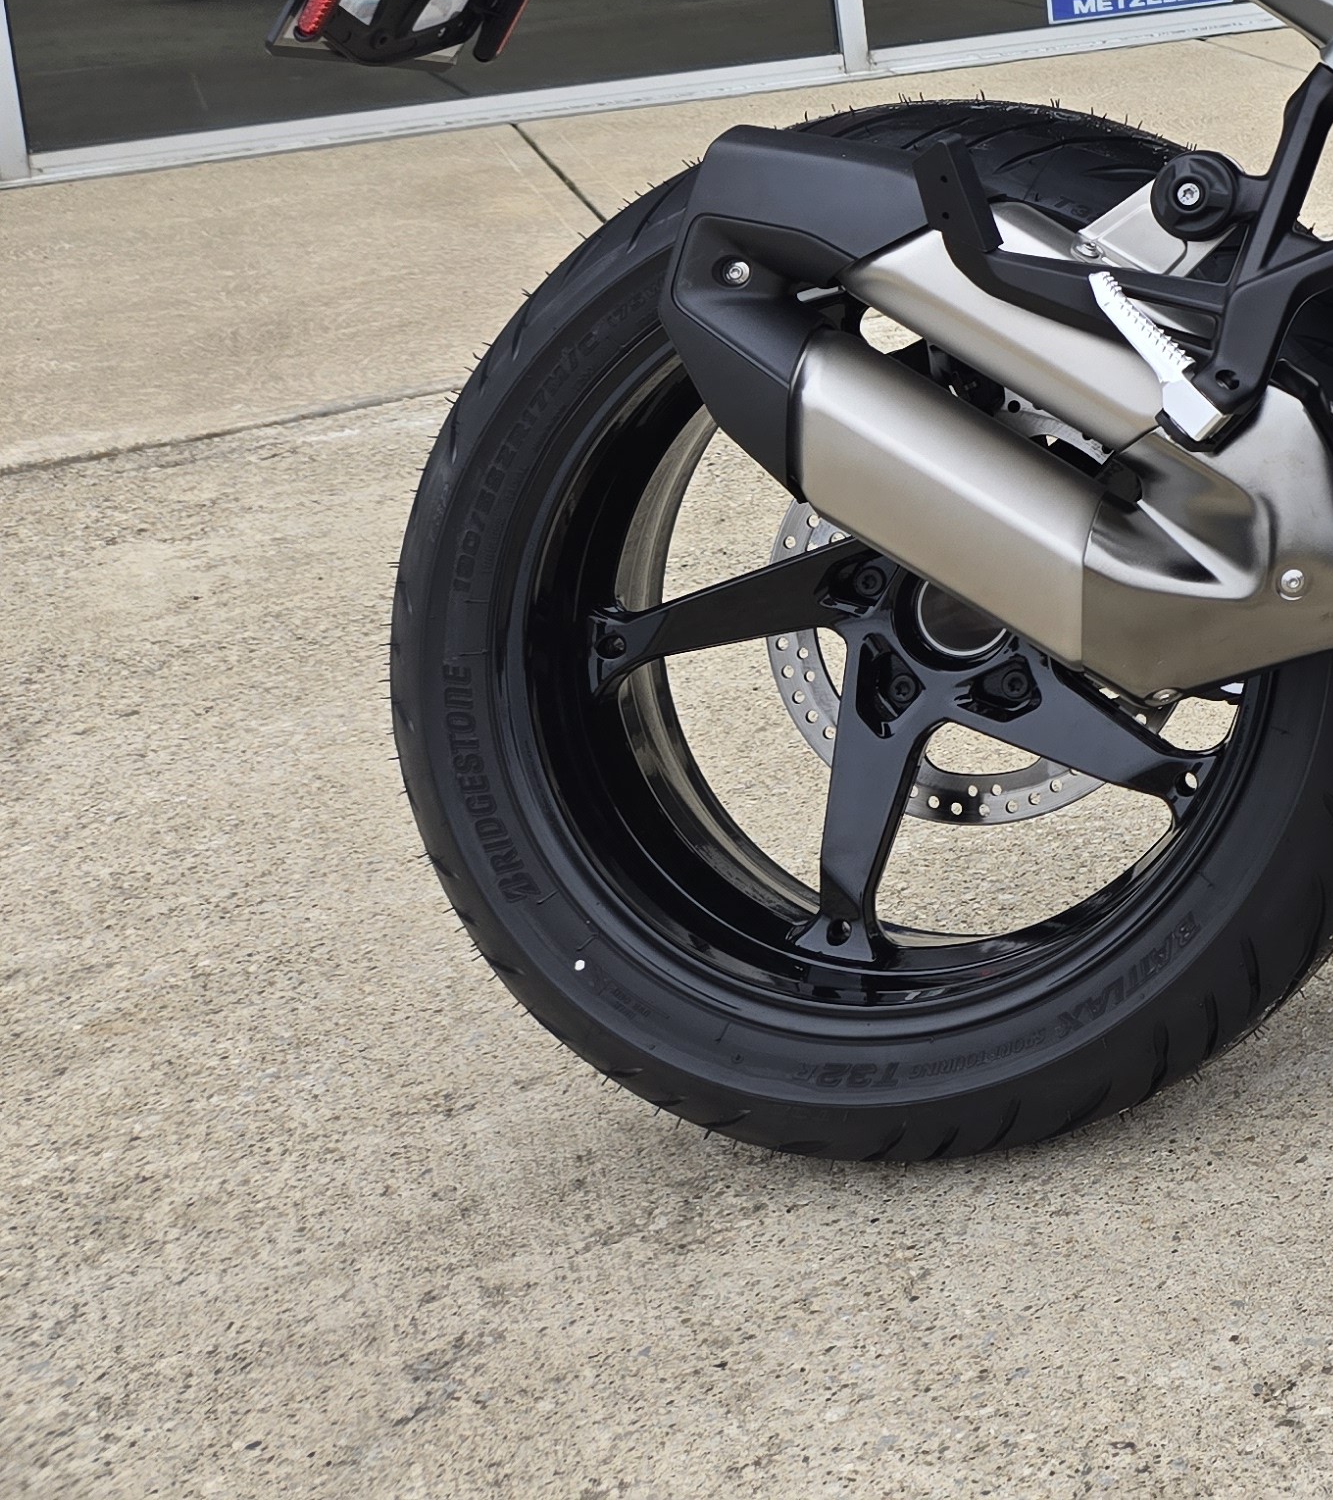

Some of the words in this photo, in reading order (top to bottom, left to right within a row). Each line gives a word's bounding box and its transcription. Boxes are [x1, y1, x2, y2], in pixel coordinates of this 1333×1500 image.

[441, 663, 541, 904] BRIDGESTONE
[1052, 911, 1202, 1037] BATTLAX
[816, 1061, 903, 1089] T32
